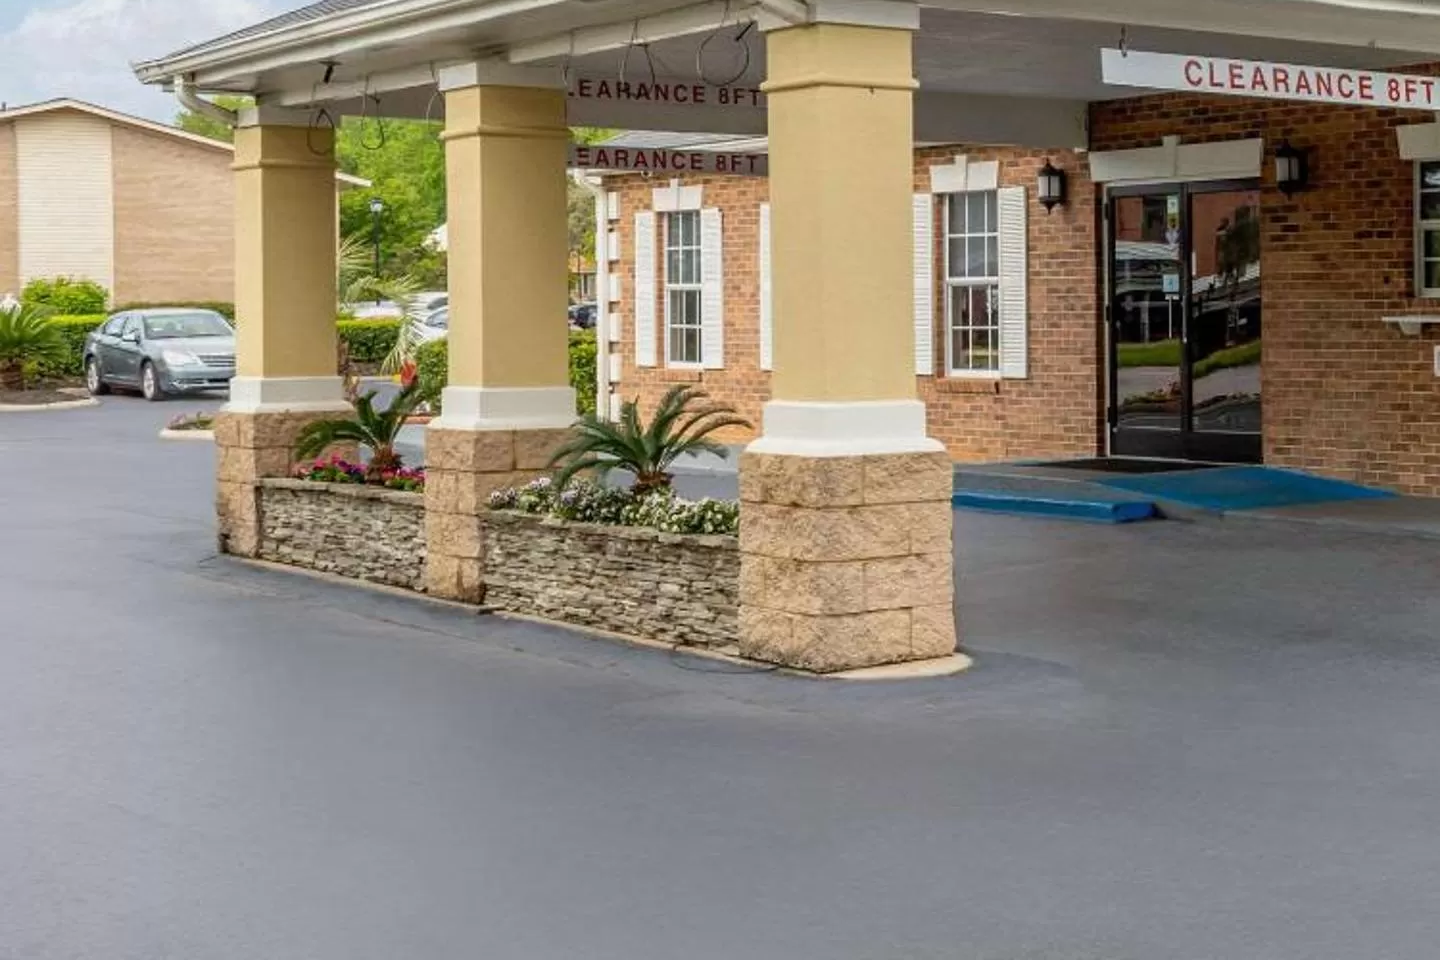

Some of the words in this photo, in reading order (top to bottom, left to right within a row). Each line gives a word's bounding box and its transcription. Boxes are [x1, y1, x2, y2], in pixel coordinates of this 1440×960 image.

[568, 79, 705, 102] EARANCE
[719, 87, 761, 106] 8FT
[1184, 59, 1374, 100] CLEARANCE
[1387, 78, 1434, 104] 8FT
[567, 147, 704, 170] EARANCE
[715, 154, 757, 173] 8FT
